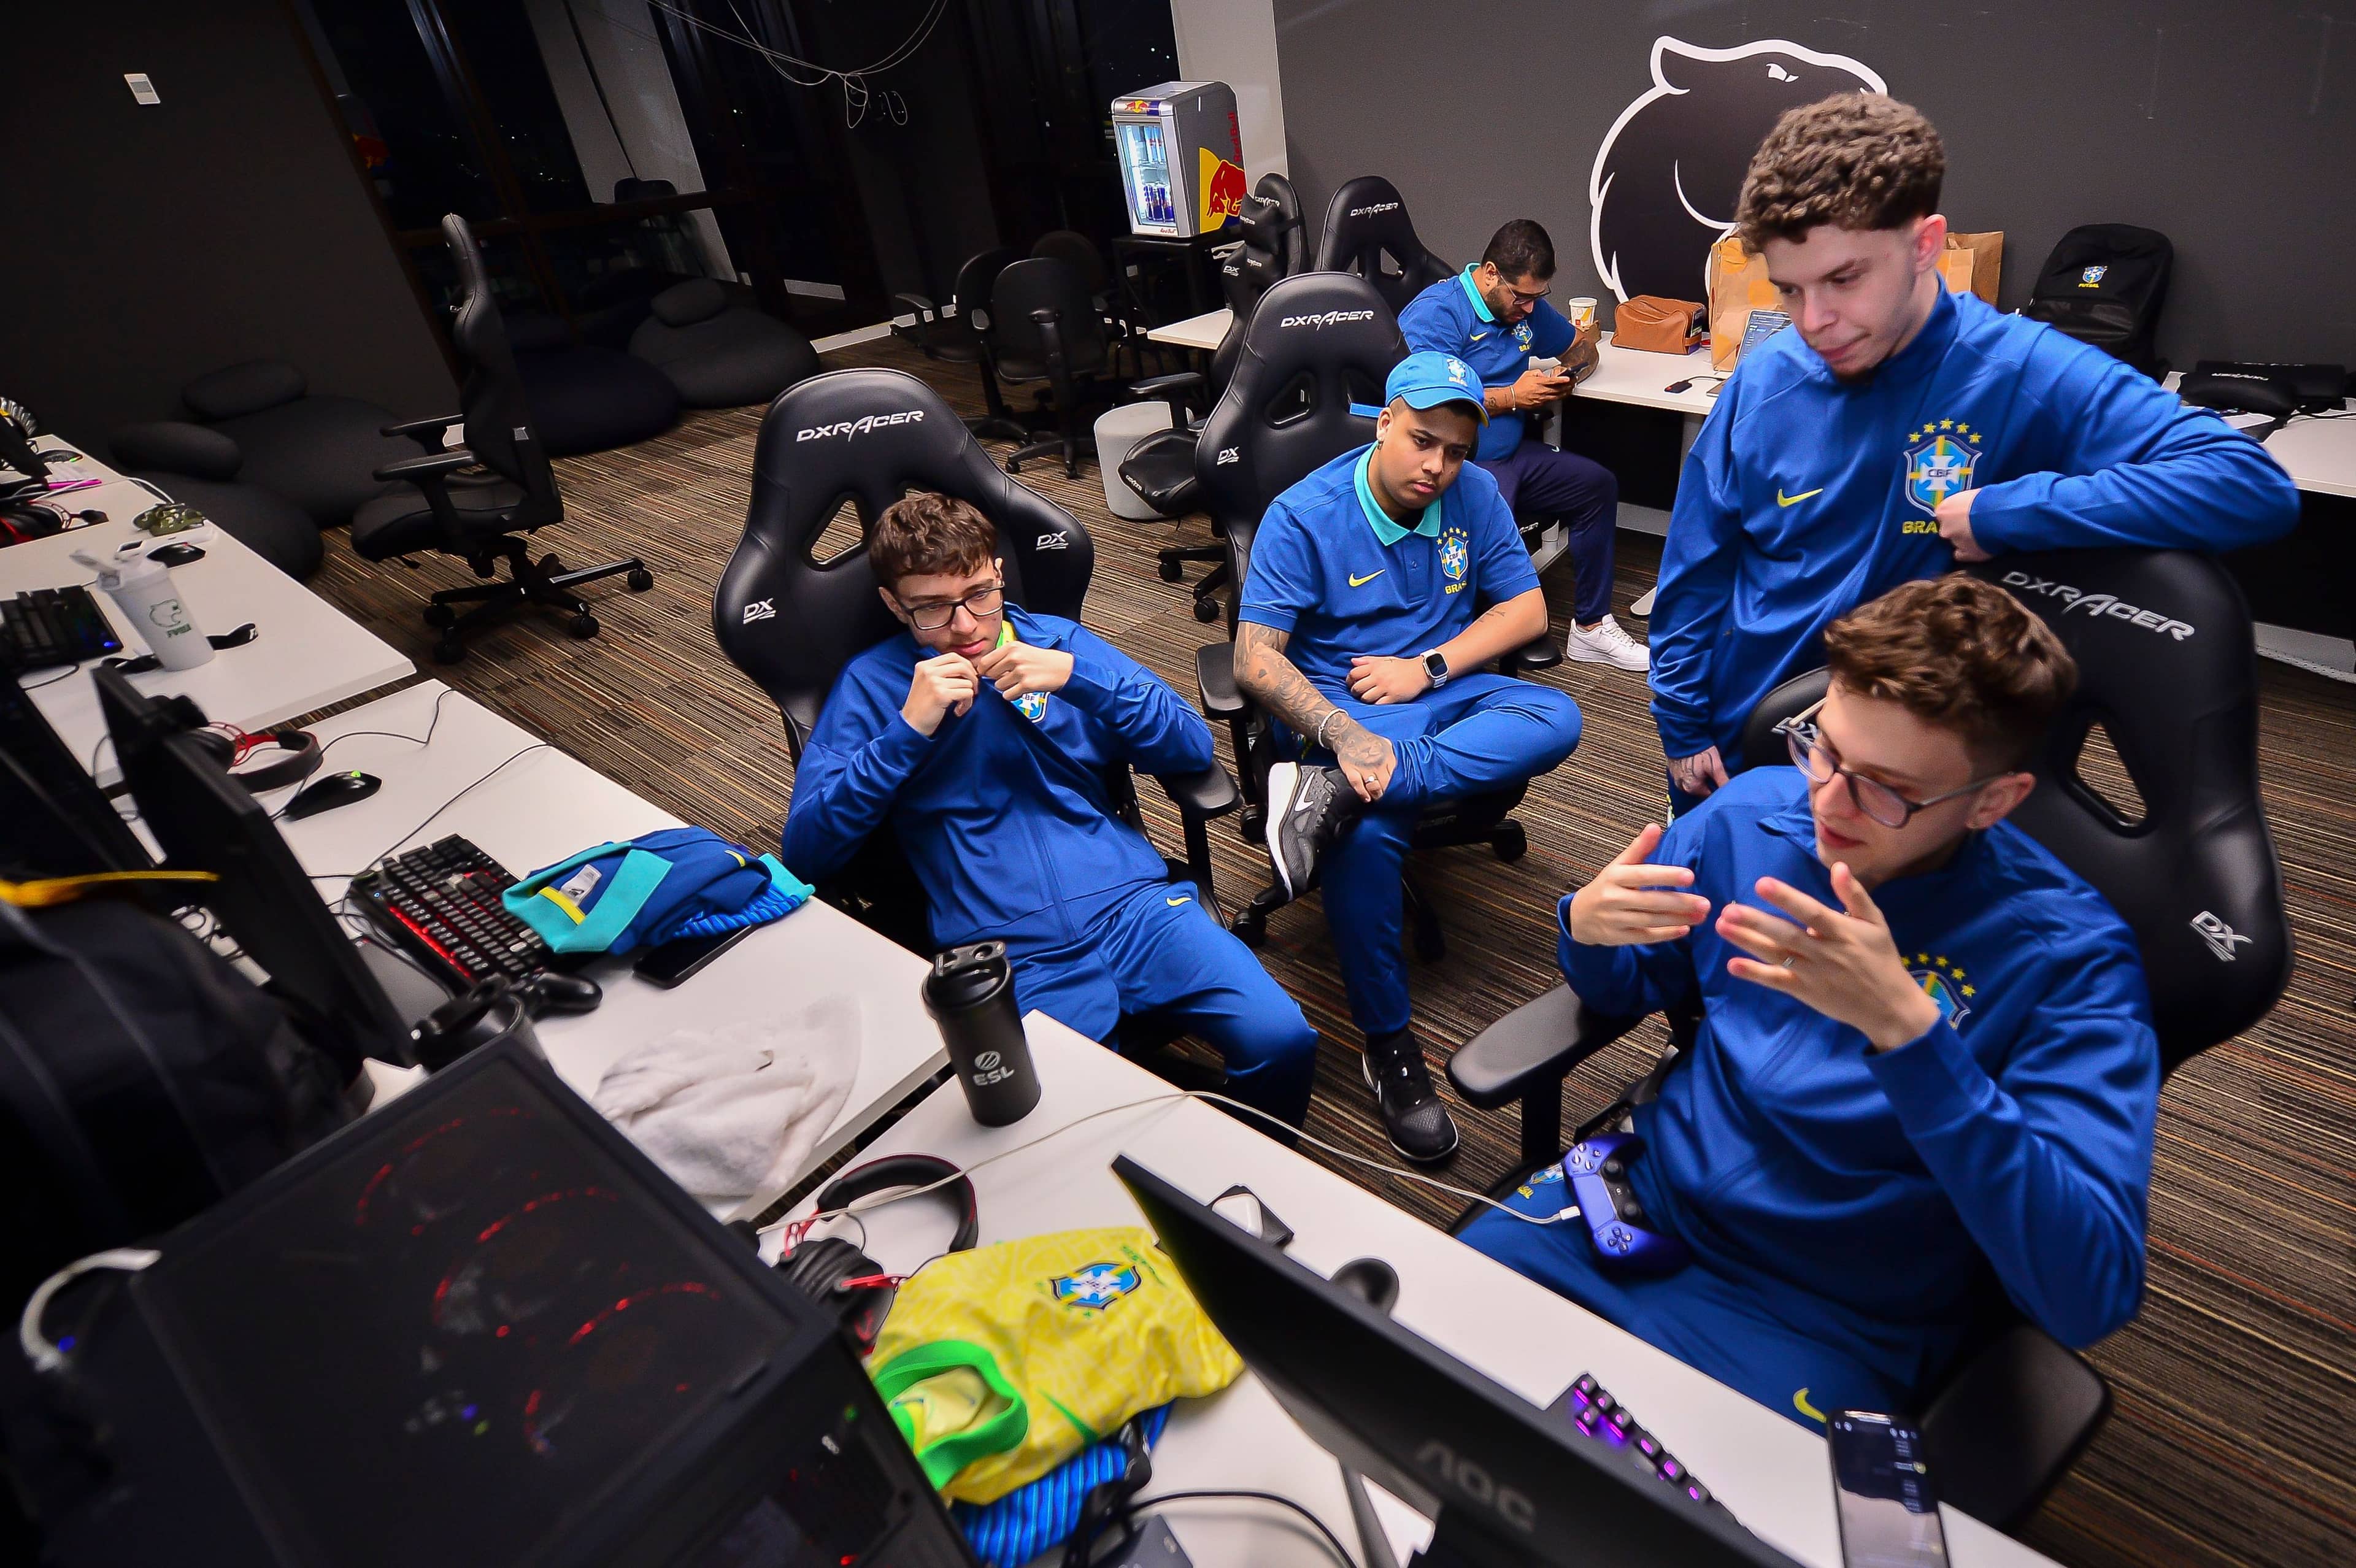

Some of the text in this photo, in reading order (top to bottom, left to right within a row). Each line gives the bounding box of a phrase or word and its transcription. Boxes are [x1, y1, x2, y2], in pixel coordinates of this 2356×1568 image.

[1350, 202, 1398, 219] DXRACER
[1280, 310, 1374, 331] DXRACER
[796, 410, 924, 442] DXRACER
[1218, 447, 1239, 464] DX
[1928, 469, 1954, 478] CBF
[1902, 520, 1939, 534] BRA
[1036, 531, 1069, 550] DX
[743, 598, 776, 622] DX
[2001, 571, 2195, 641] DXRACER
[2190, 910, 2253, 959] DX
[972, 1066, 1015, 1086] ESL
[1415, 1440, 1536, 1533] AOC
